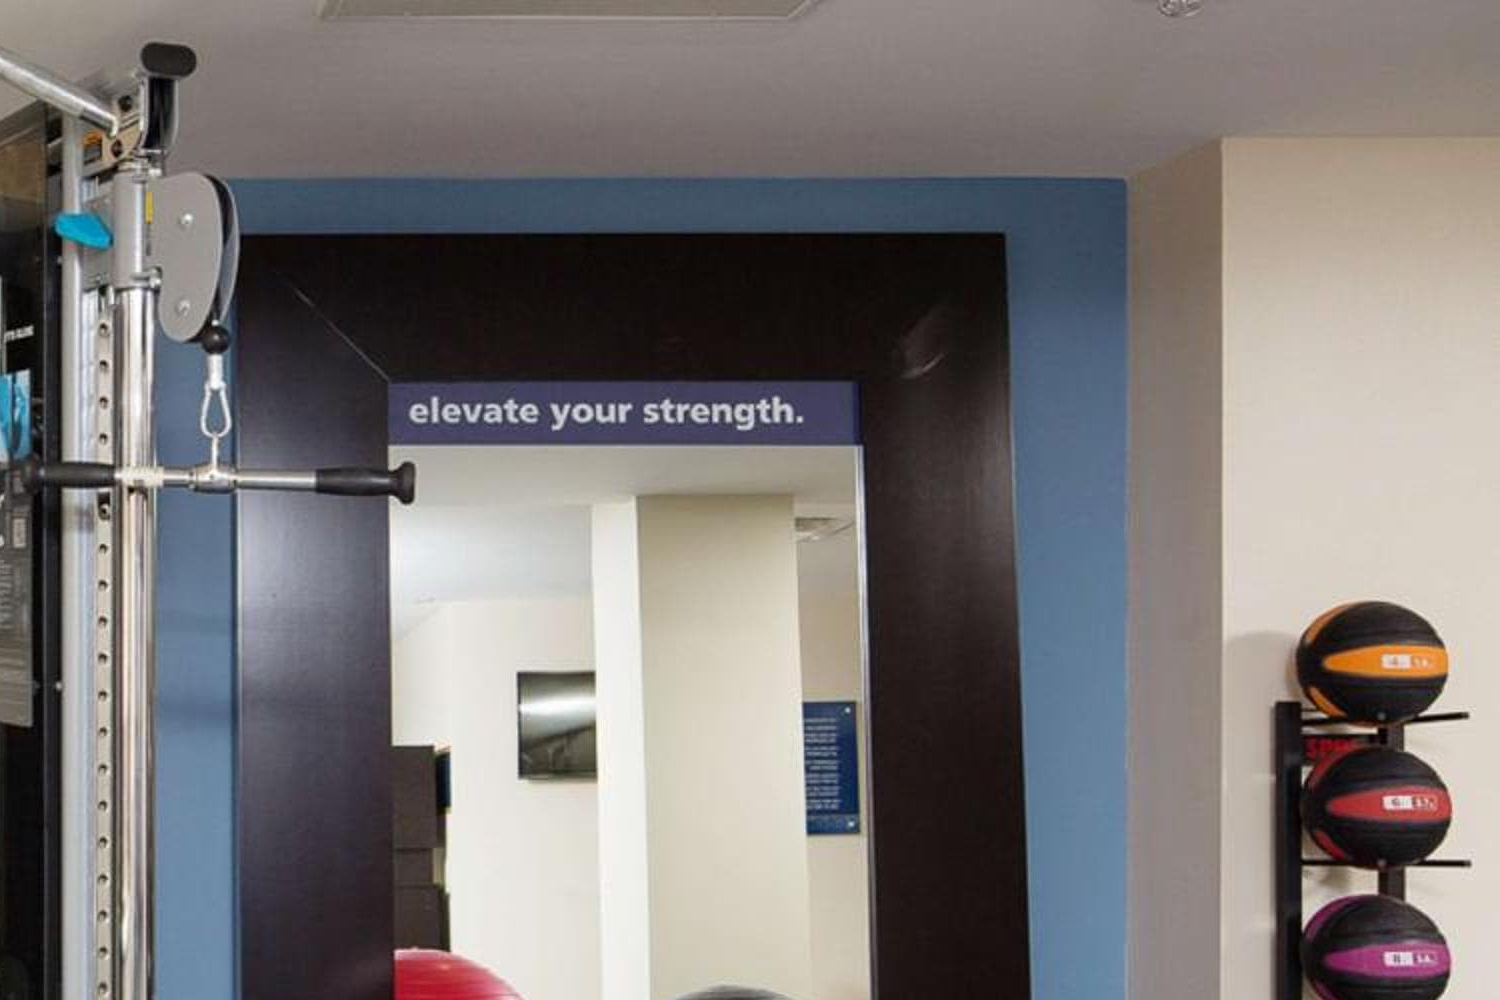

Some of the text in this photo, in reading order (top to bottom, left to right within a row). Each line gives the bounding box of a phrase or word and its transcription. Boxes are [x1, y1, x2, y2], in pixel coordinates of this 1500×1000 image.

[408, 397, 804, 431] elevate your strength.
